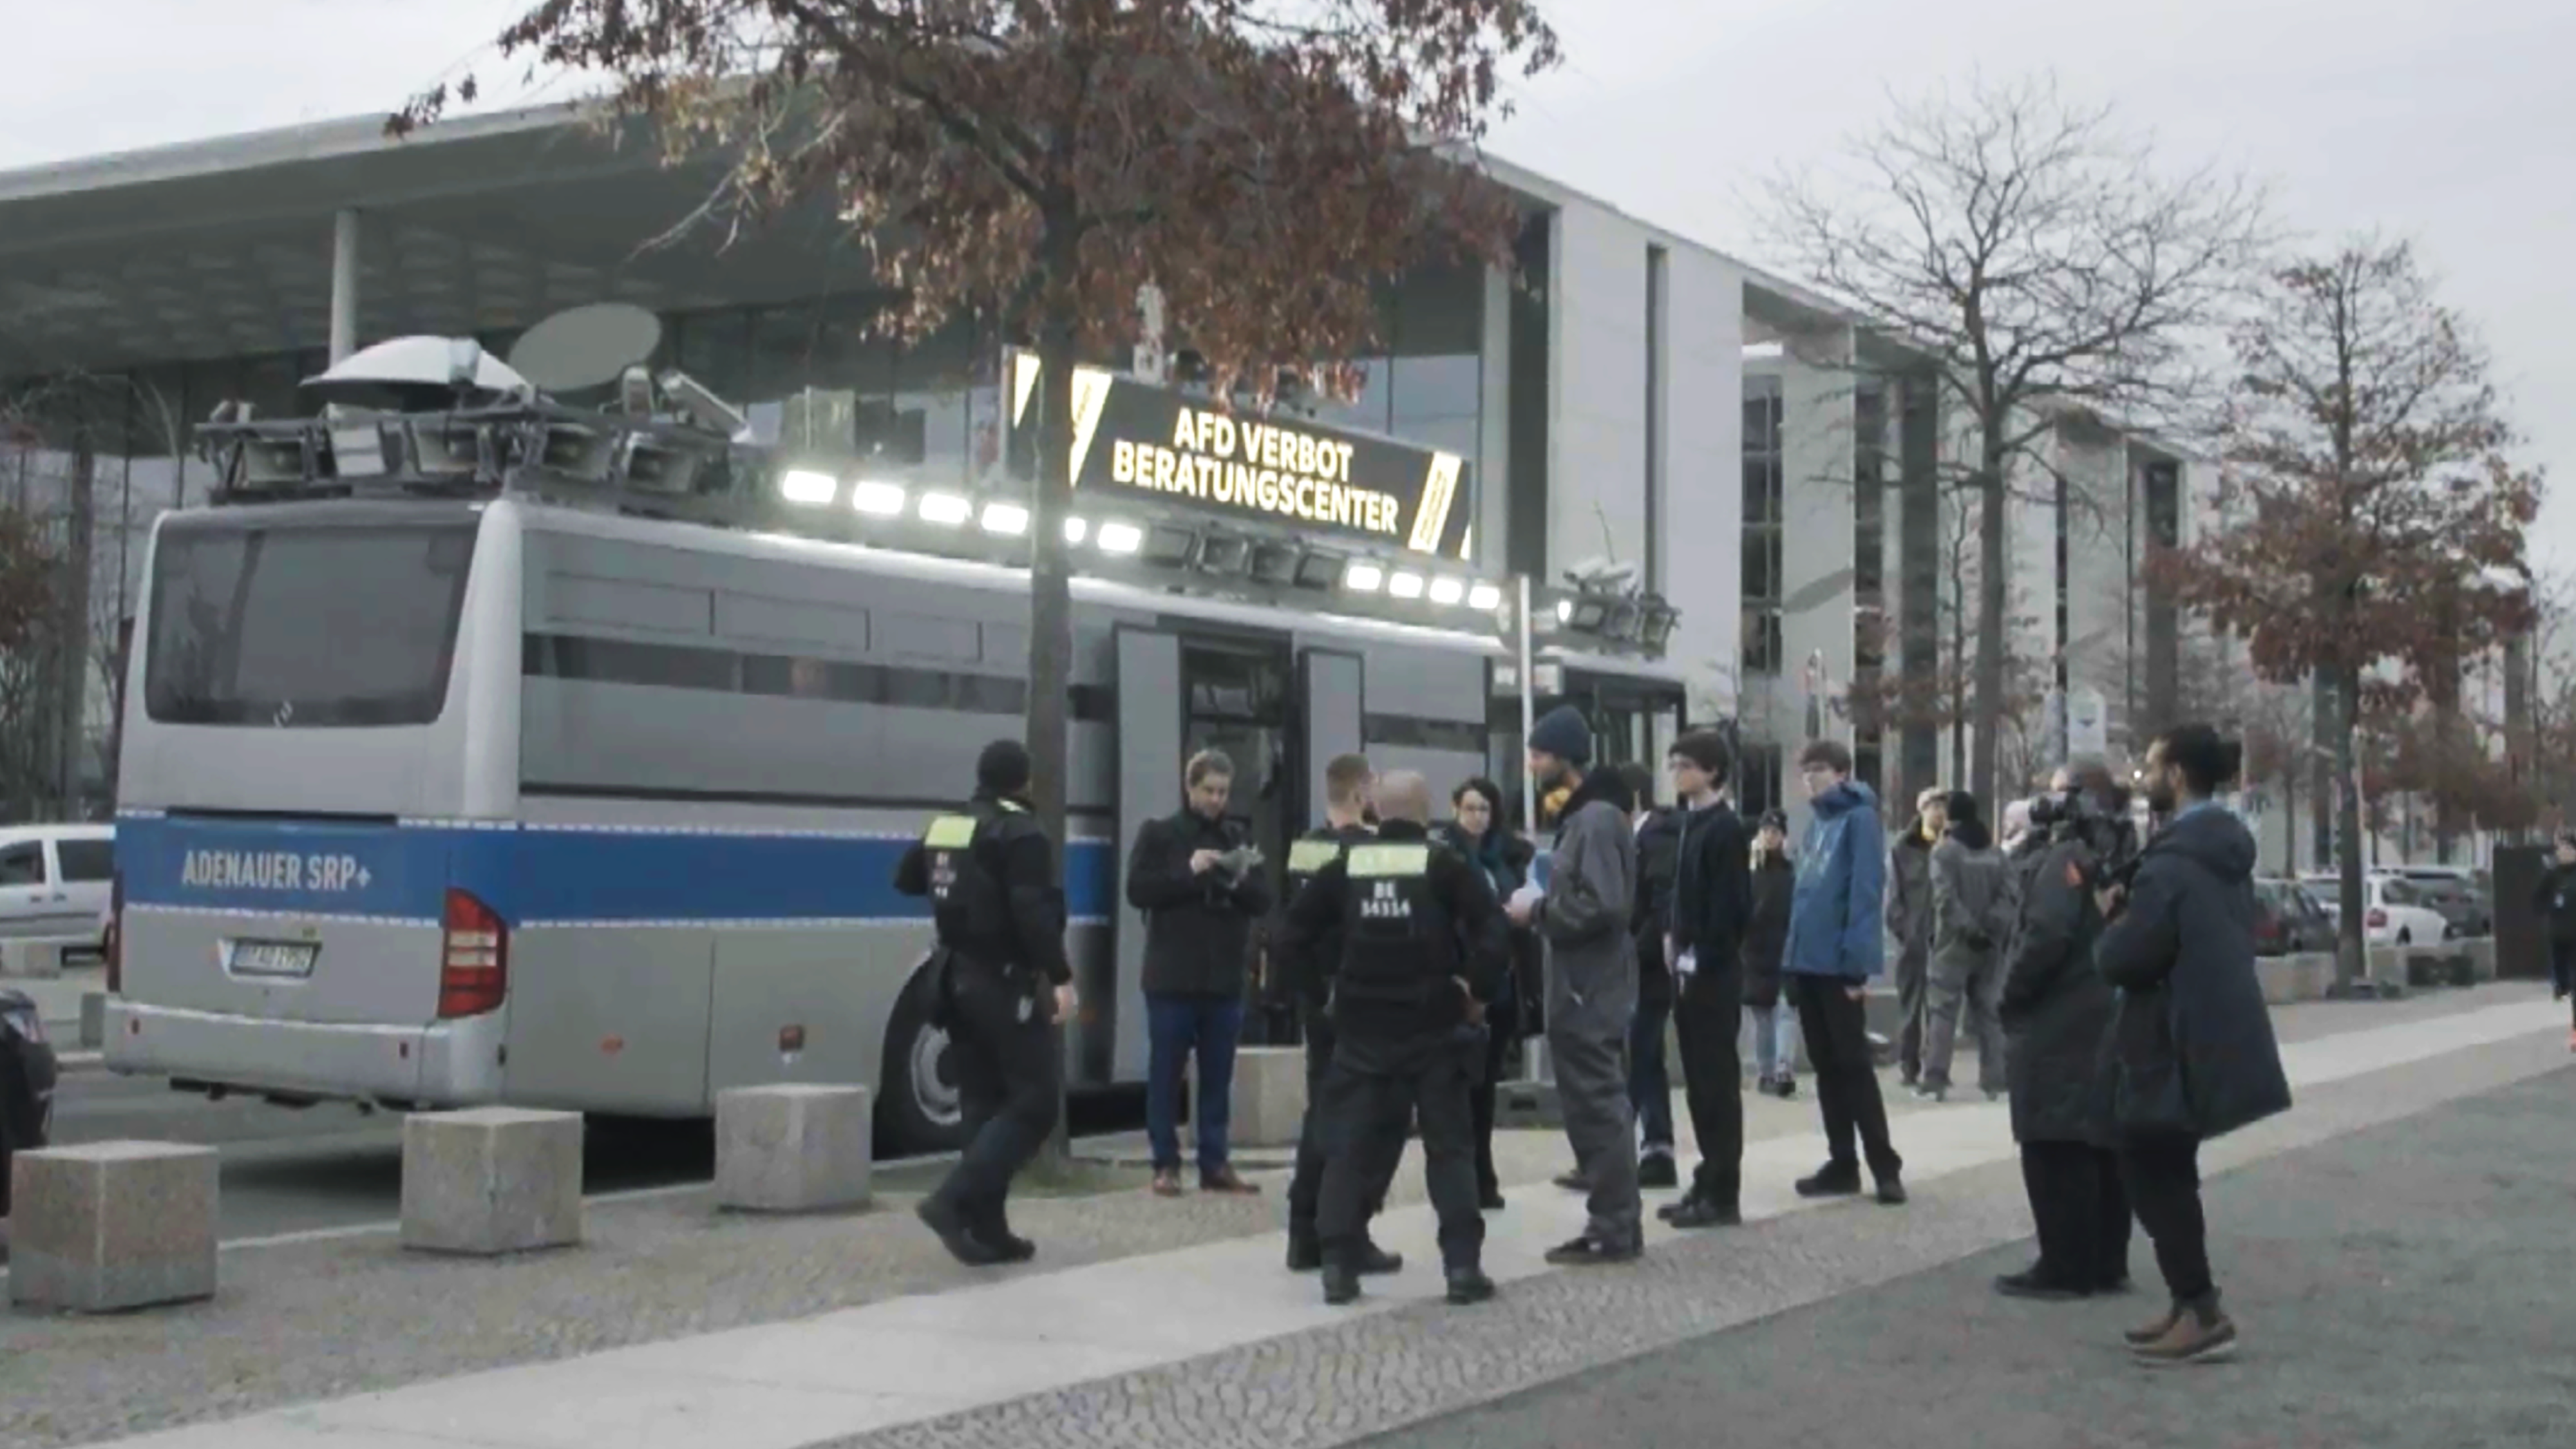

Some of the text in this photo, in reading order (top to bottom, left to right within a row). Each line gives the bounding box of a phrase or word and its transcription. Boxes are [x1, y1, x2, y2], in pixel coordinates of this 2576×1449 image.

[1174, 407, 1354, 482] AFD VERBOT
[1112, 438, 1399, 534] BERATUNGSCENTER
[182, 849, 301, 889] ADENAUER
